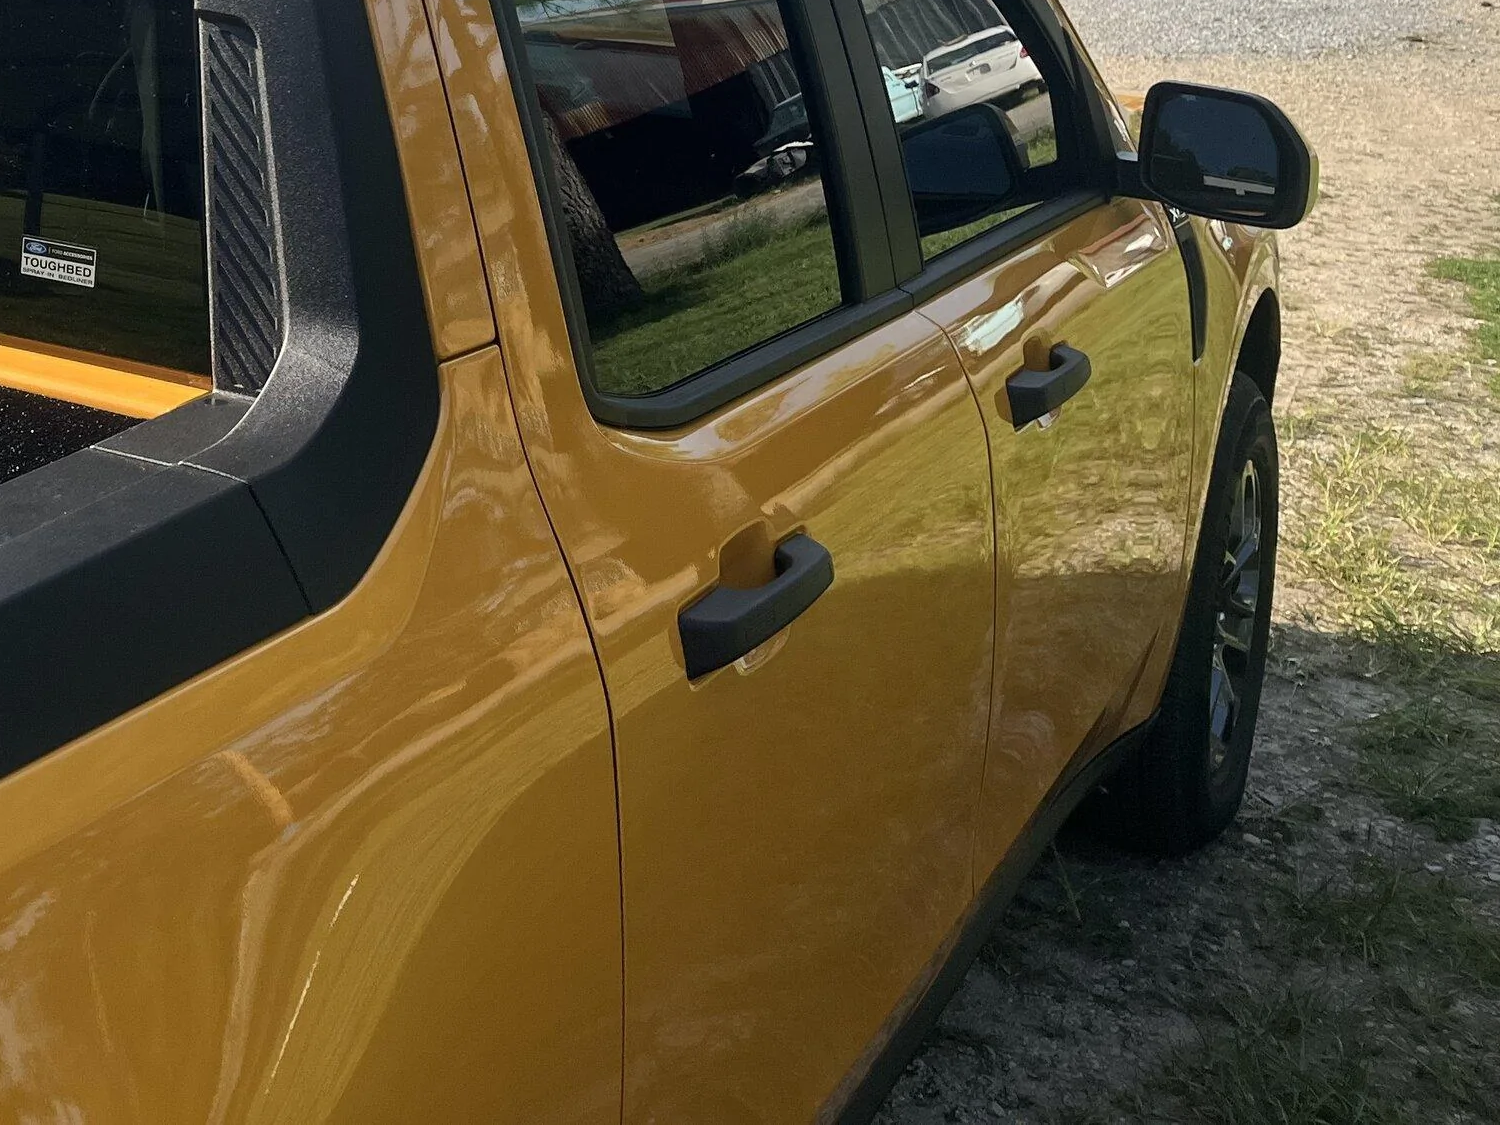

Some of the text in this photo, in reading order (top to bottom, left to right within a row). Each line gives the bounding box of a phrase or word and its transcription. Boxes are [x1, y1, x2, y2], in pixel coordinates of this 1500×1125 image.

[22, 267, 45, 276] SPRAY
[58, 274, 93, 286] BEDLINER
[23, 256, 92, 278] TOUGHBED
